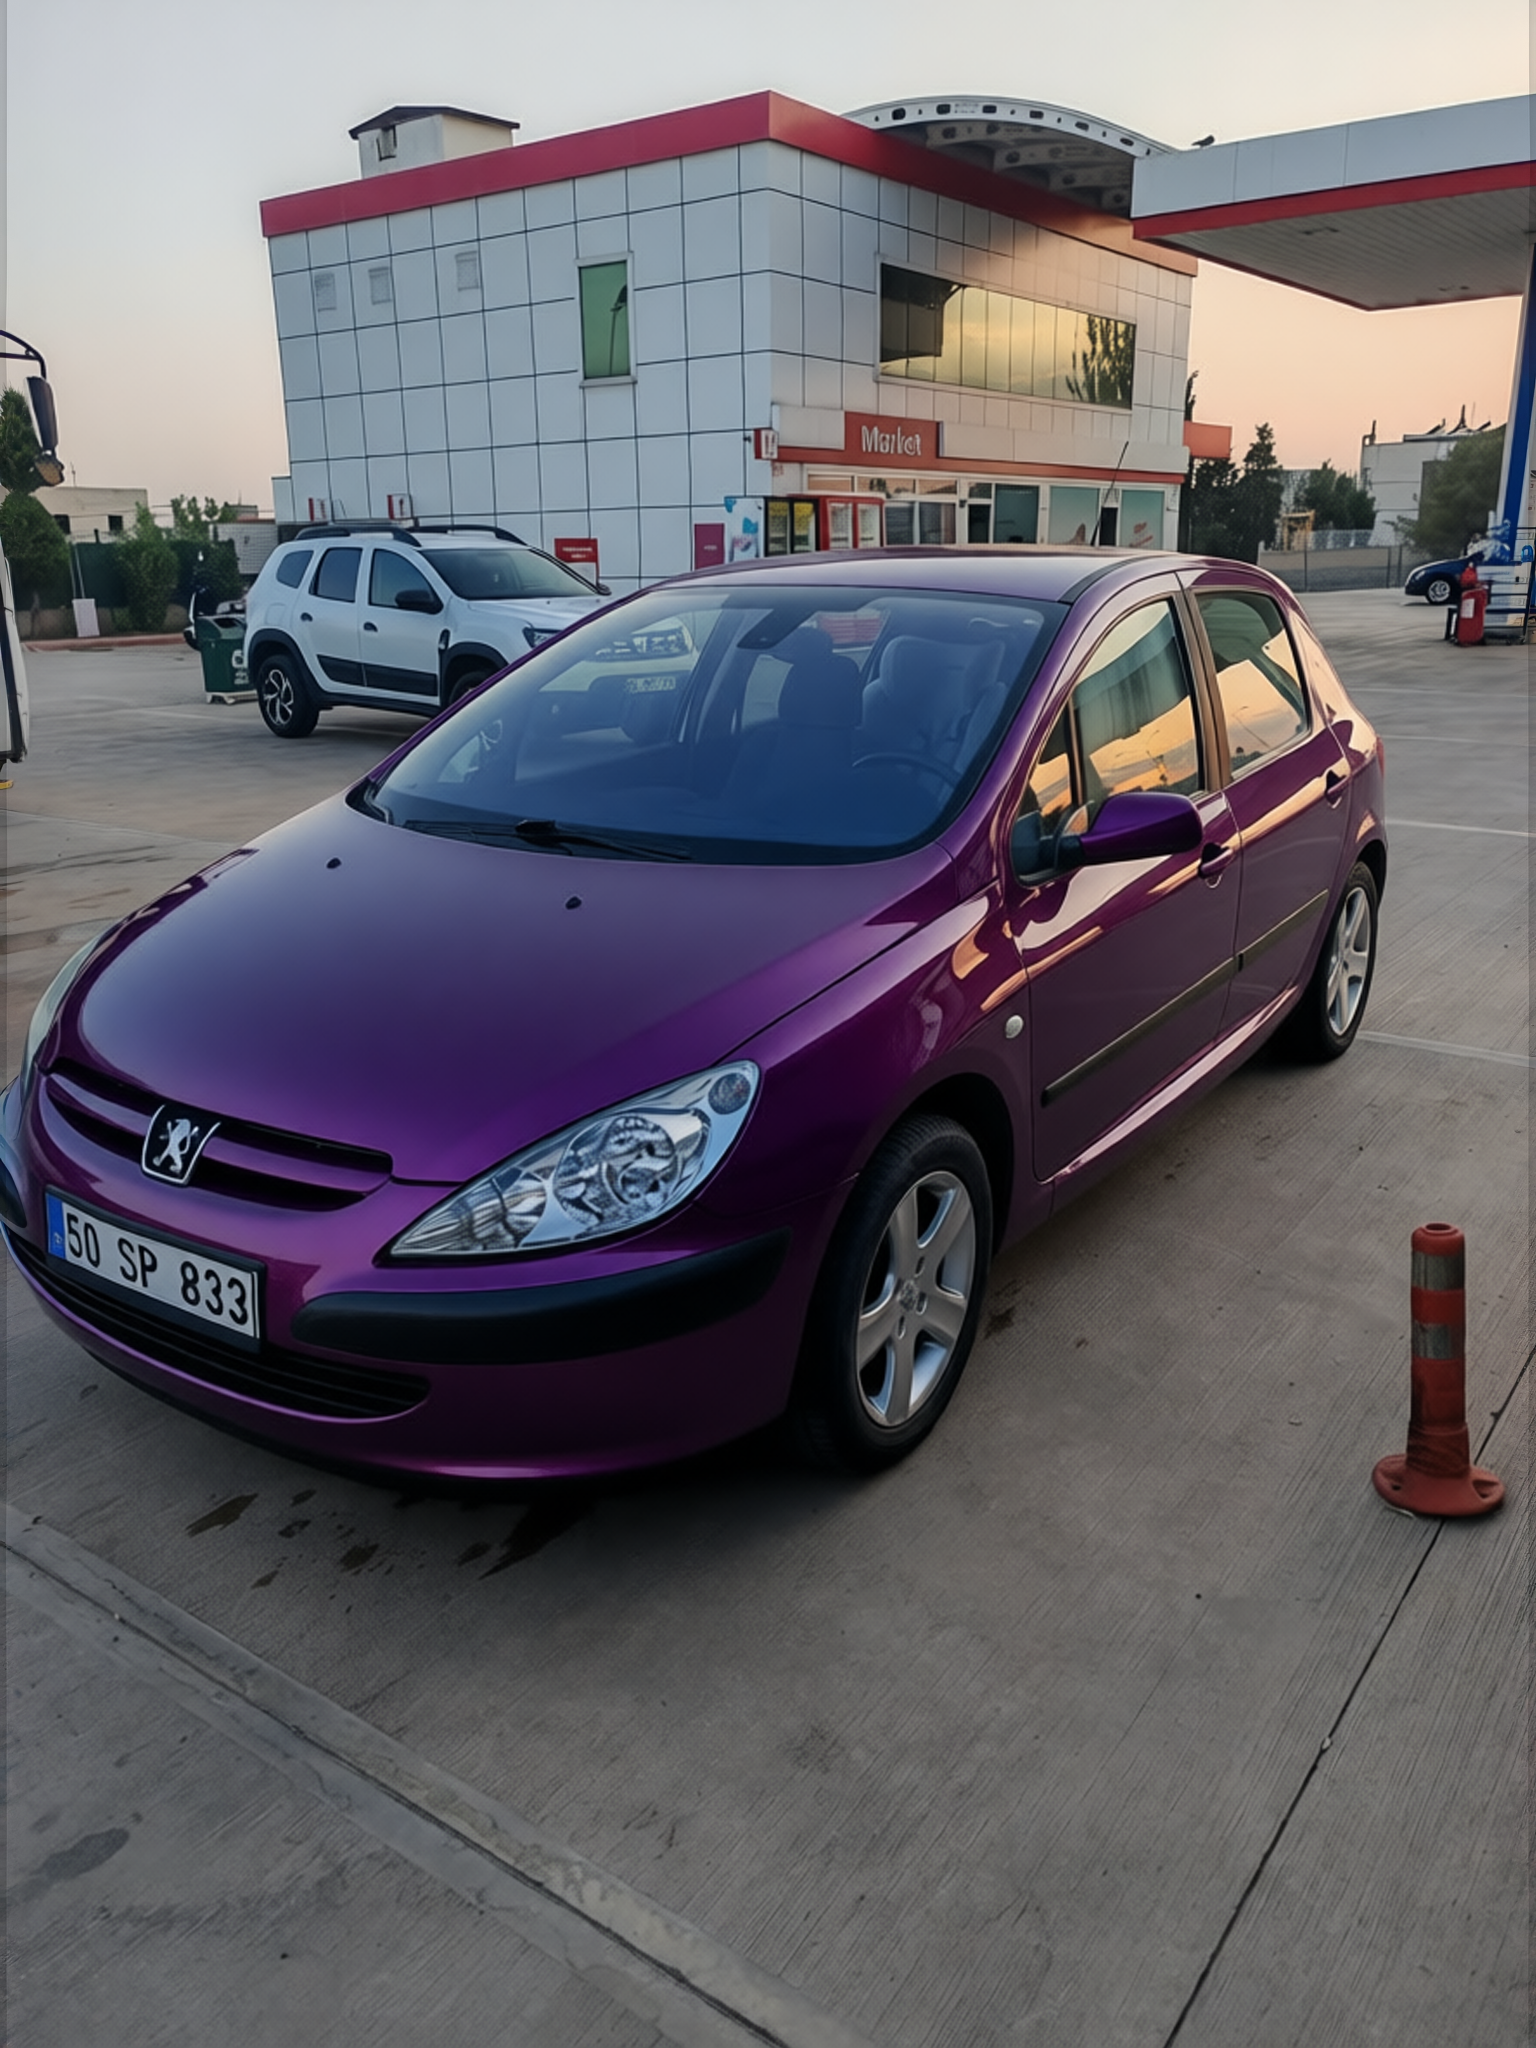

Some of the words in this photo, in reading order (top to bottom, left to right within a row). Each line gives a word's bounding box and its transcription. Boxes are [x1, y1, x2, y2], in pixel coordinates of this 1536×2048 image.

[66, 1212, 100, 1268] 50
[118, 1238, 157, 1288] SP
[180, 1261, 248, 1325] 833
